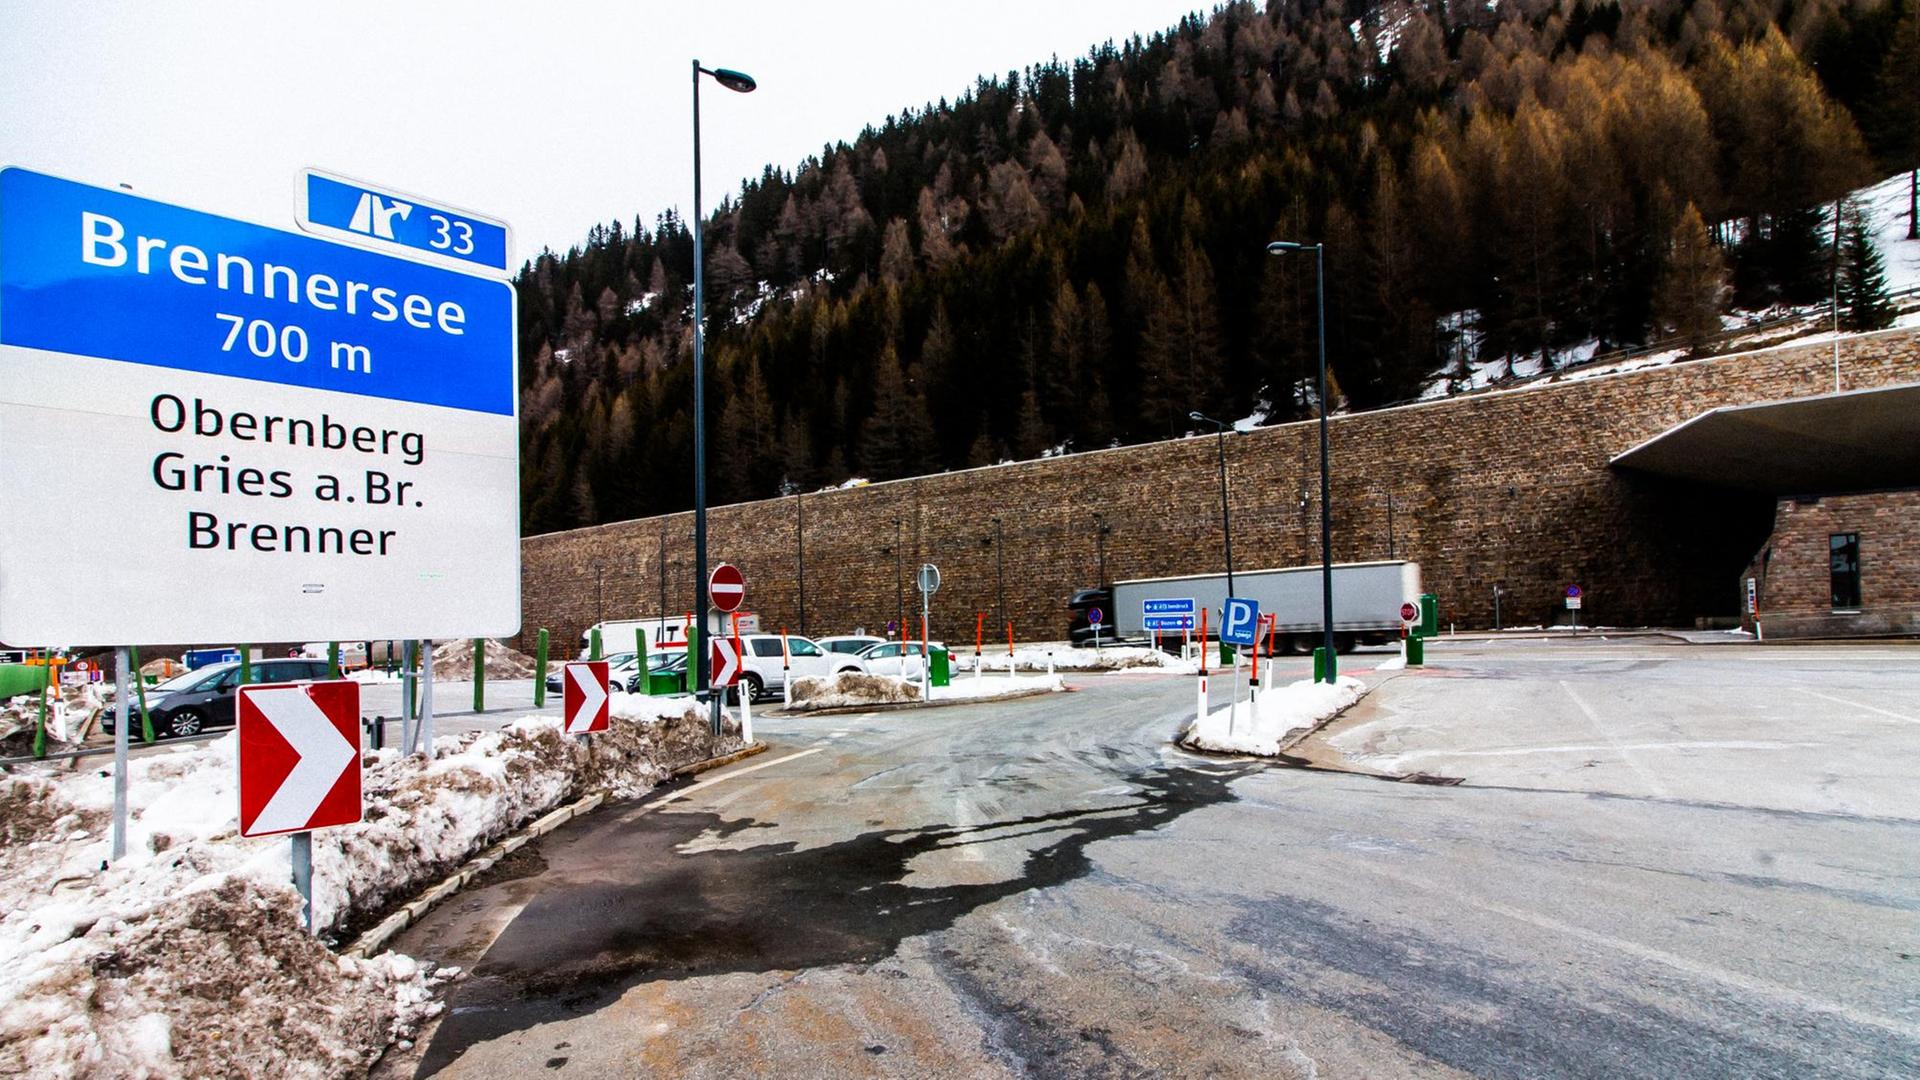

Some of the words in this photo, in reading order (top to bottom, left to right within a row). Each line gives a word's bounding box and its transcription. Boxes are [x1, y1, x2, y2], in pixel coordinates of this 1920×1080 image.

[429, 214, 474, 255] 33
[82, 211, 466, 336] Brennersee
[215, 312, 308, 363] 700
[331, 341, 371, 374] m
[151, 394, 425, 466] Obernberg
[153, 452, 293, 498] Gries
[315, 470, 423, 508] a.Br.
[189, 511, 396, 556] Brenner
[1227, 602, 1251, 636] P
[1401, 608, 1414, 616] STOP
